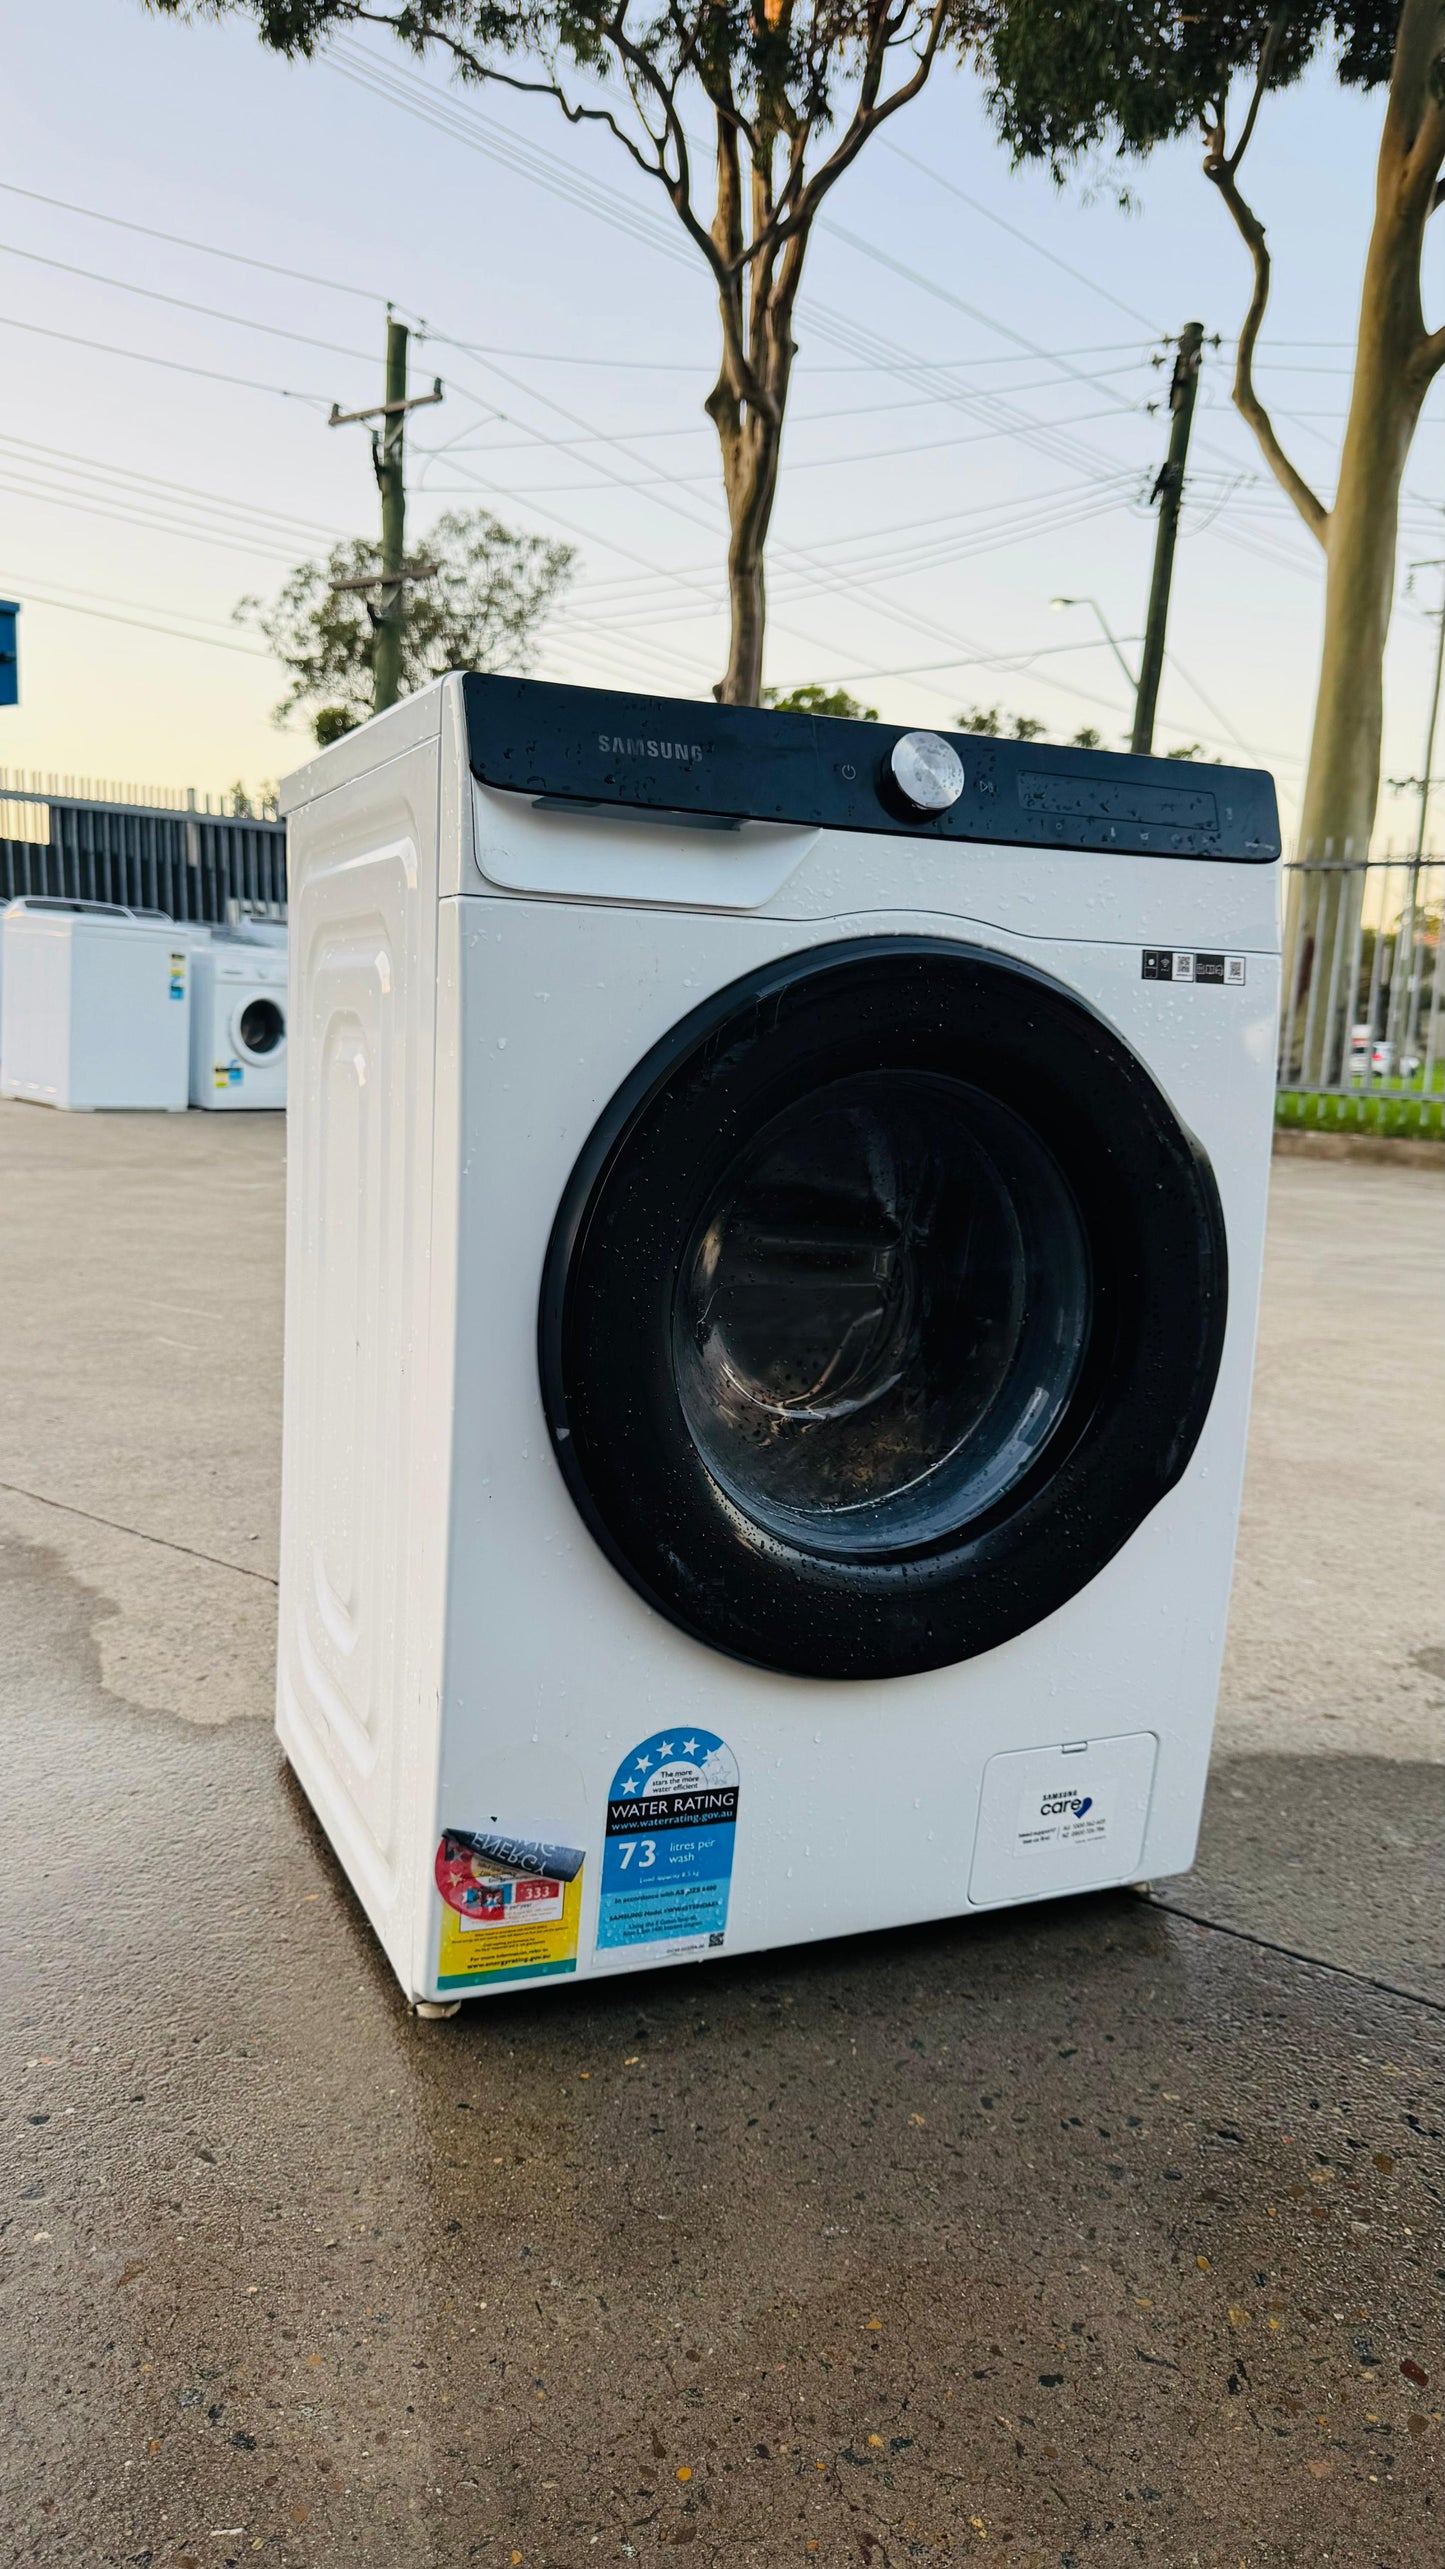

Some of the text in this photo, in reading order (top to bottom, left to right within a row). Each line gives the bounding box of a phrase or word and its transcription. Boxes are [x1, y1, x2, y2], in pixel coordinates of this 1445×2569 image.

[598, 733, 703, 762] SAMSUNG
[661, 1769, 693, 1779] The more
[652, 1775, 700, 1787] stars the more
[652, 1782, 698, 1793] water efficient
[1043, 1789, 1078, 1802] SAMSUNG
[611, 1792, 735, 1819] WATER RATING
[1040, 1798, 1081, 1816] care
[611, 1810, 733, 1831] www.waterrating.gov.au
[669, 1839, 716, 1852] litres per
[618, 1839, 657, 1870] 73
[668, 1852, 695, 1864] wash
[524, 1886, 550, 1900] 333
